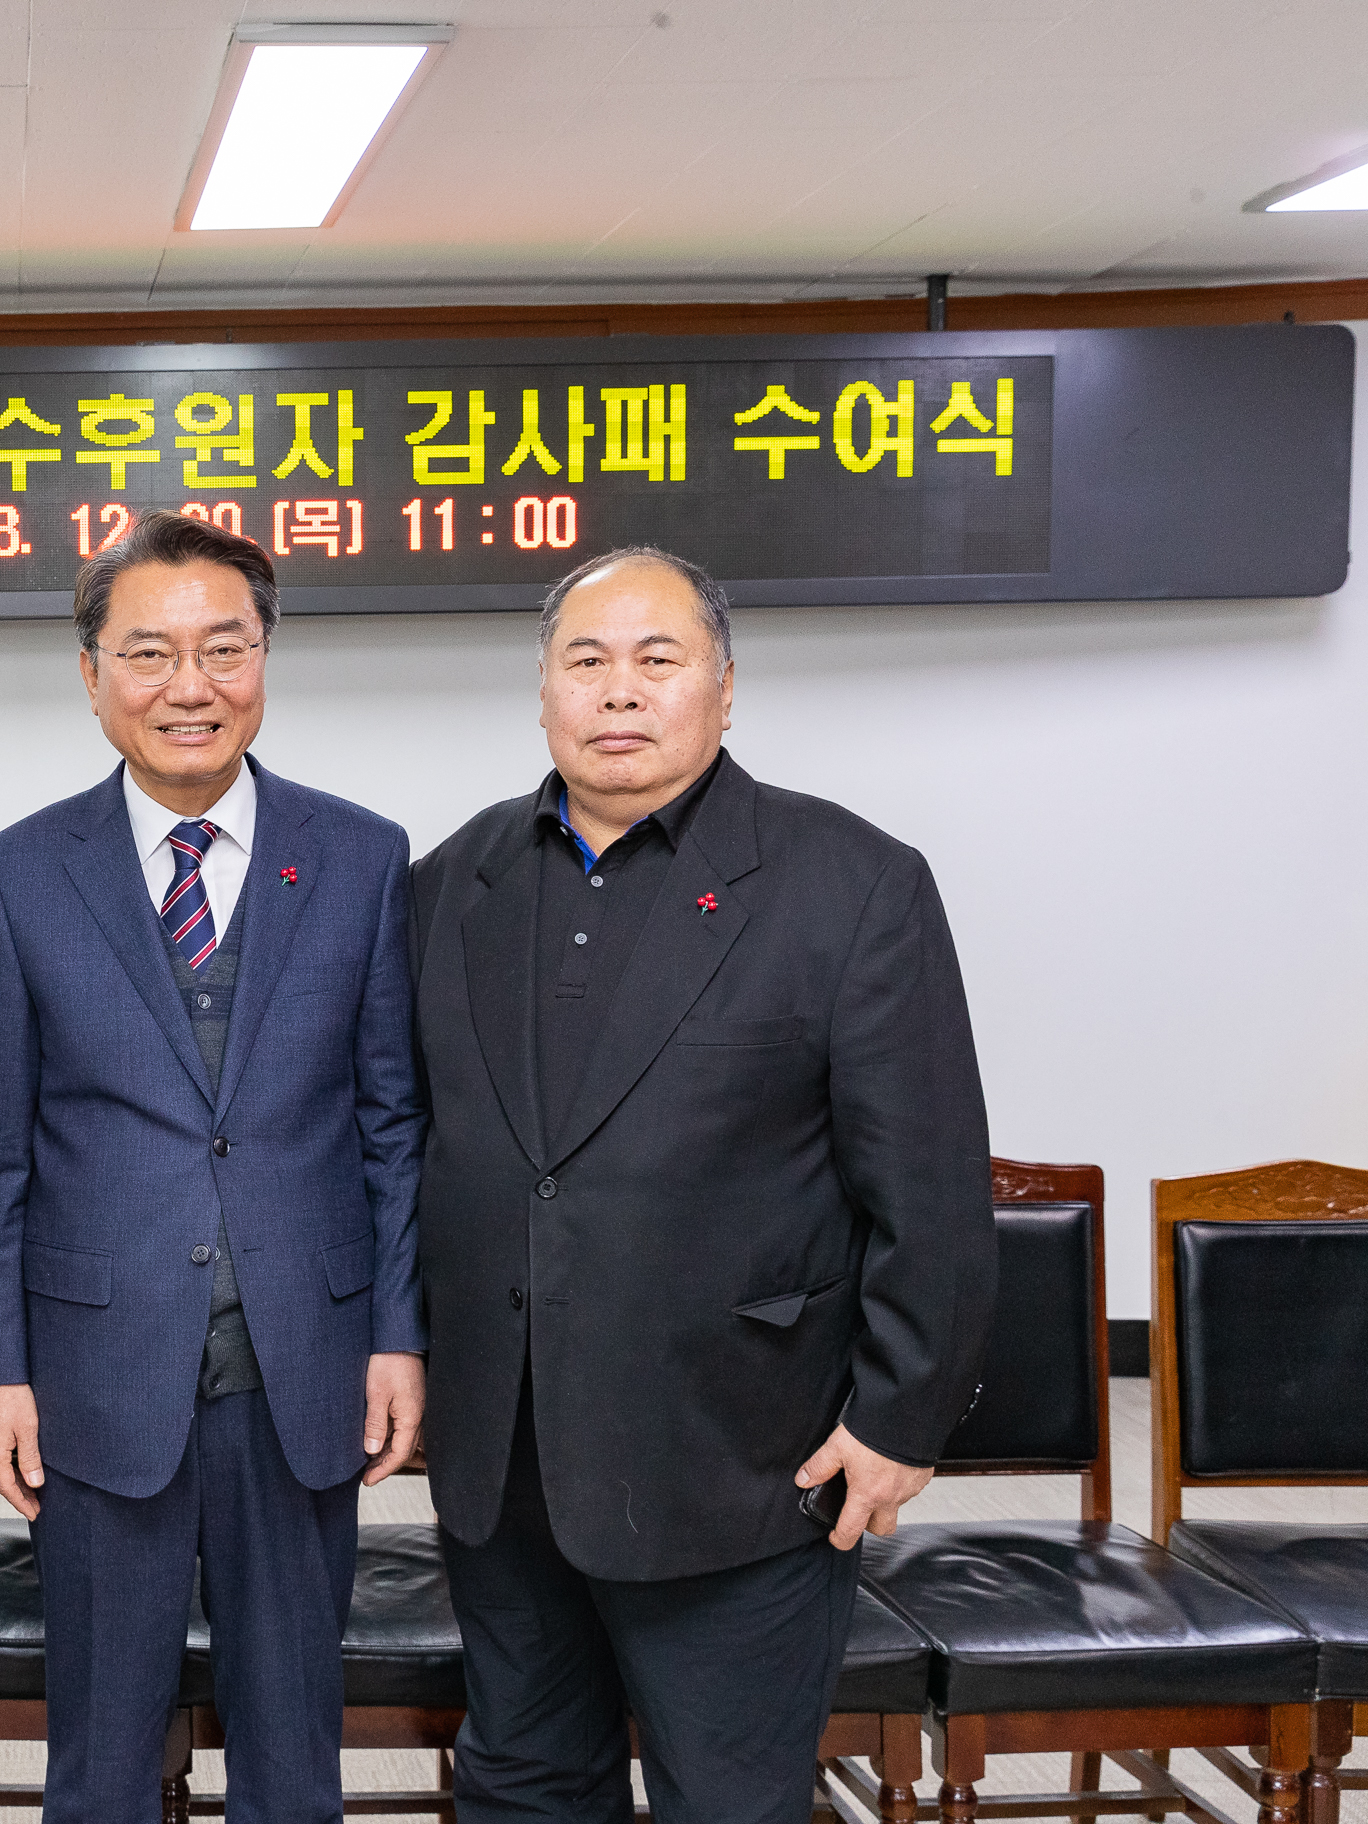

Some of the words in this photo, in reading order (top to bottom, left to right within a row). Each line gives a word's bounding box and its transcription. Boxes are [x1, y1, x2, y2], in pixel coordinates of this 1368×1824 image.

[404, 384, 688, 487] 감사패
[733, 377, 1016, 482] 수여식
[272, 499, 364, 558] [목]
